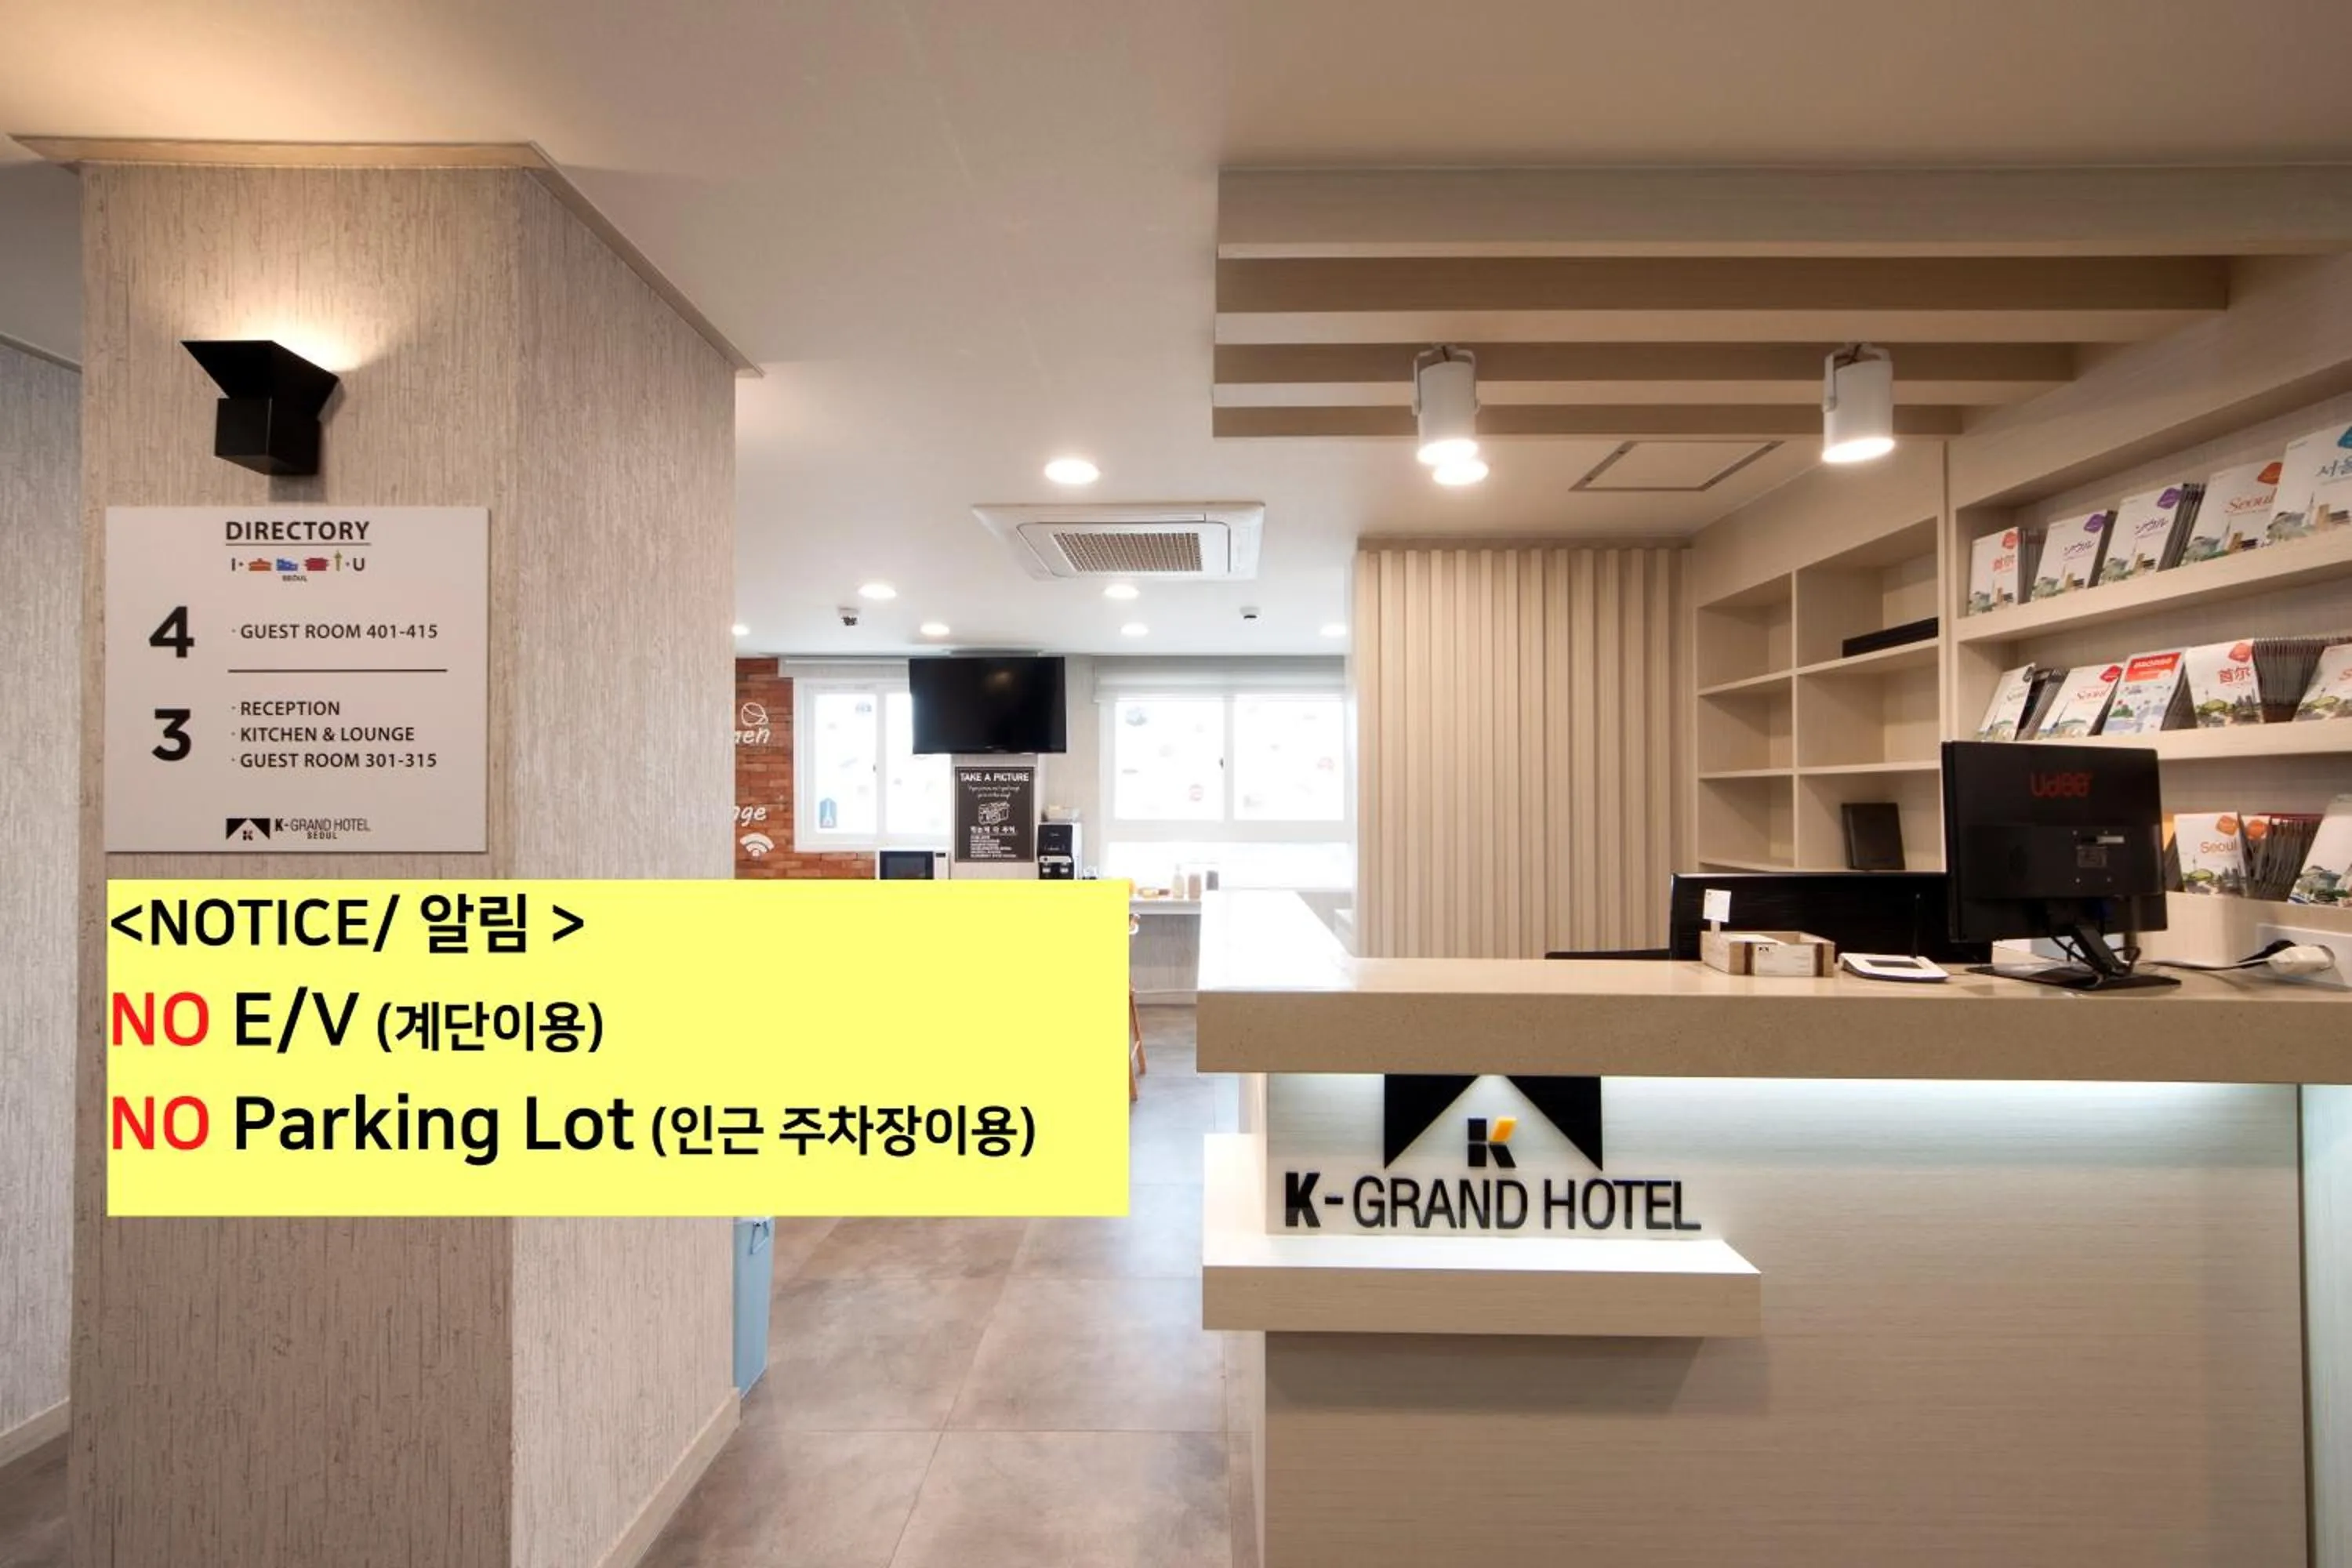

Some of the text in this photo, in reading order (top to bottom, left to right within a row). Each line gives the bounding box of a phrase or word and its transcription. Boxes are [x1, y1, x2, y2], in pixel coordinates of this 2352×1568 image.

[226, 521, 370, 540] DIRECTORY
[149, 606, 194, 659] 4
[240, 624, 438, 640] GUEST ROOM 401-415
[240, 701, 340, 716] RECEPTION
[151, 709, 191, 761] 3
[240, 728, 415, 742] KITCHEN & LOUNGE
[240, 753, 437, 768] GUEST ROOM 301-315
[960, 772, 1029, 782] TAKE A PICTURE
[274, 818, 371, 832] K-GRAND HOTEL
[307, 832, 338, 840] SEOUL
[2200, 840, 2237, 854] Seoul
[1285, 1172, 1701, 1231] K-GRAND HOTEL
